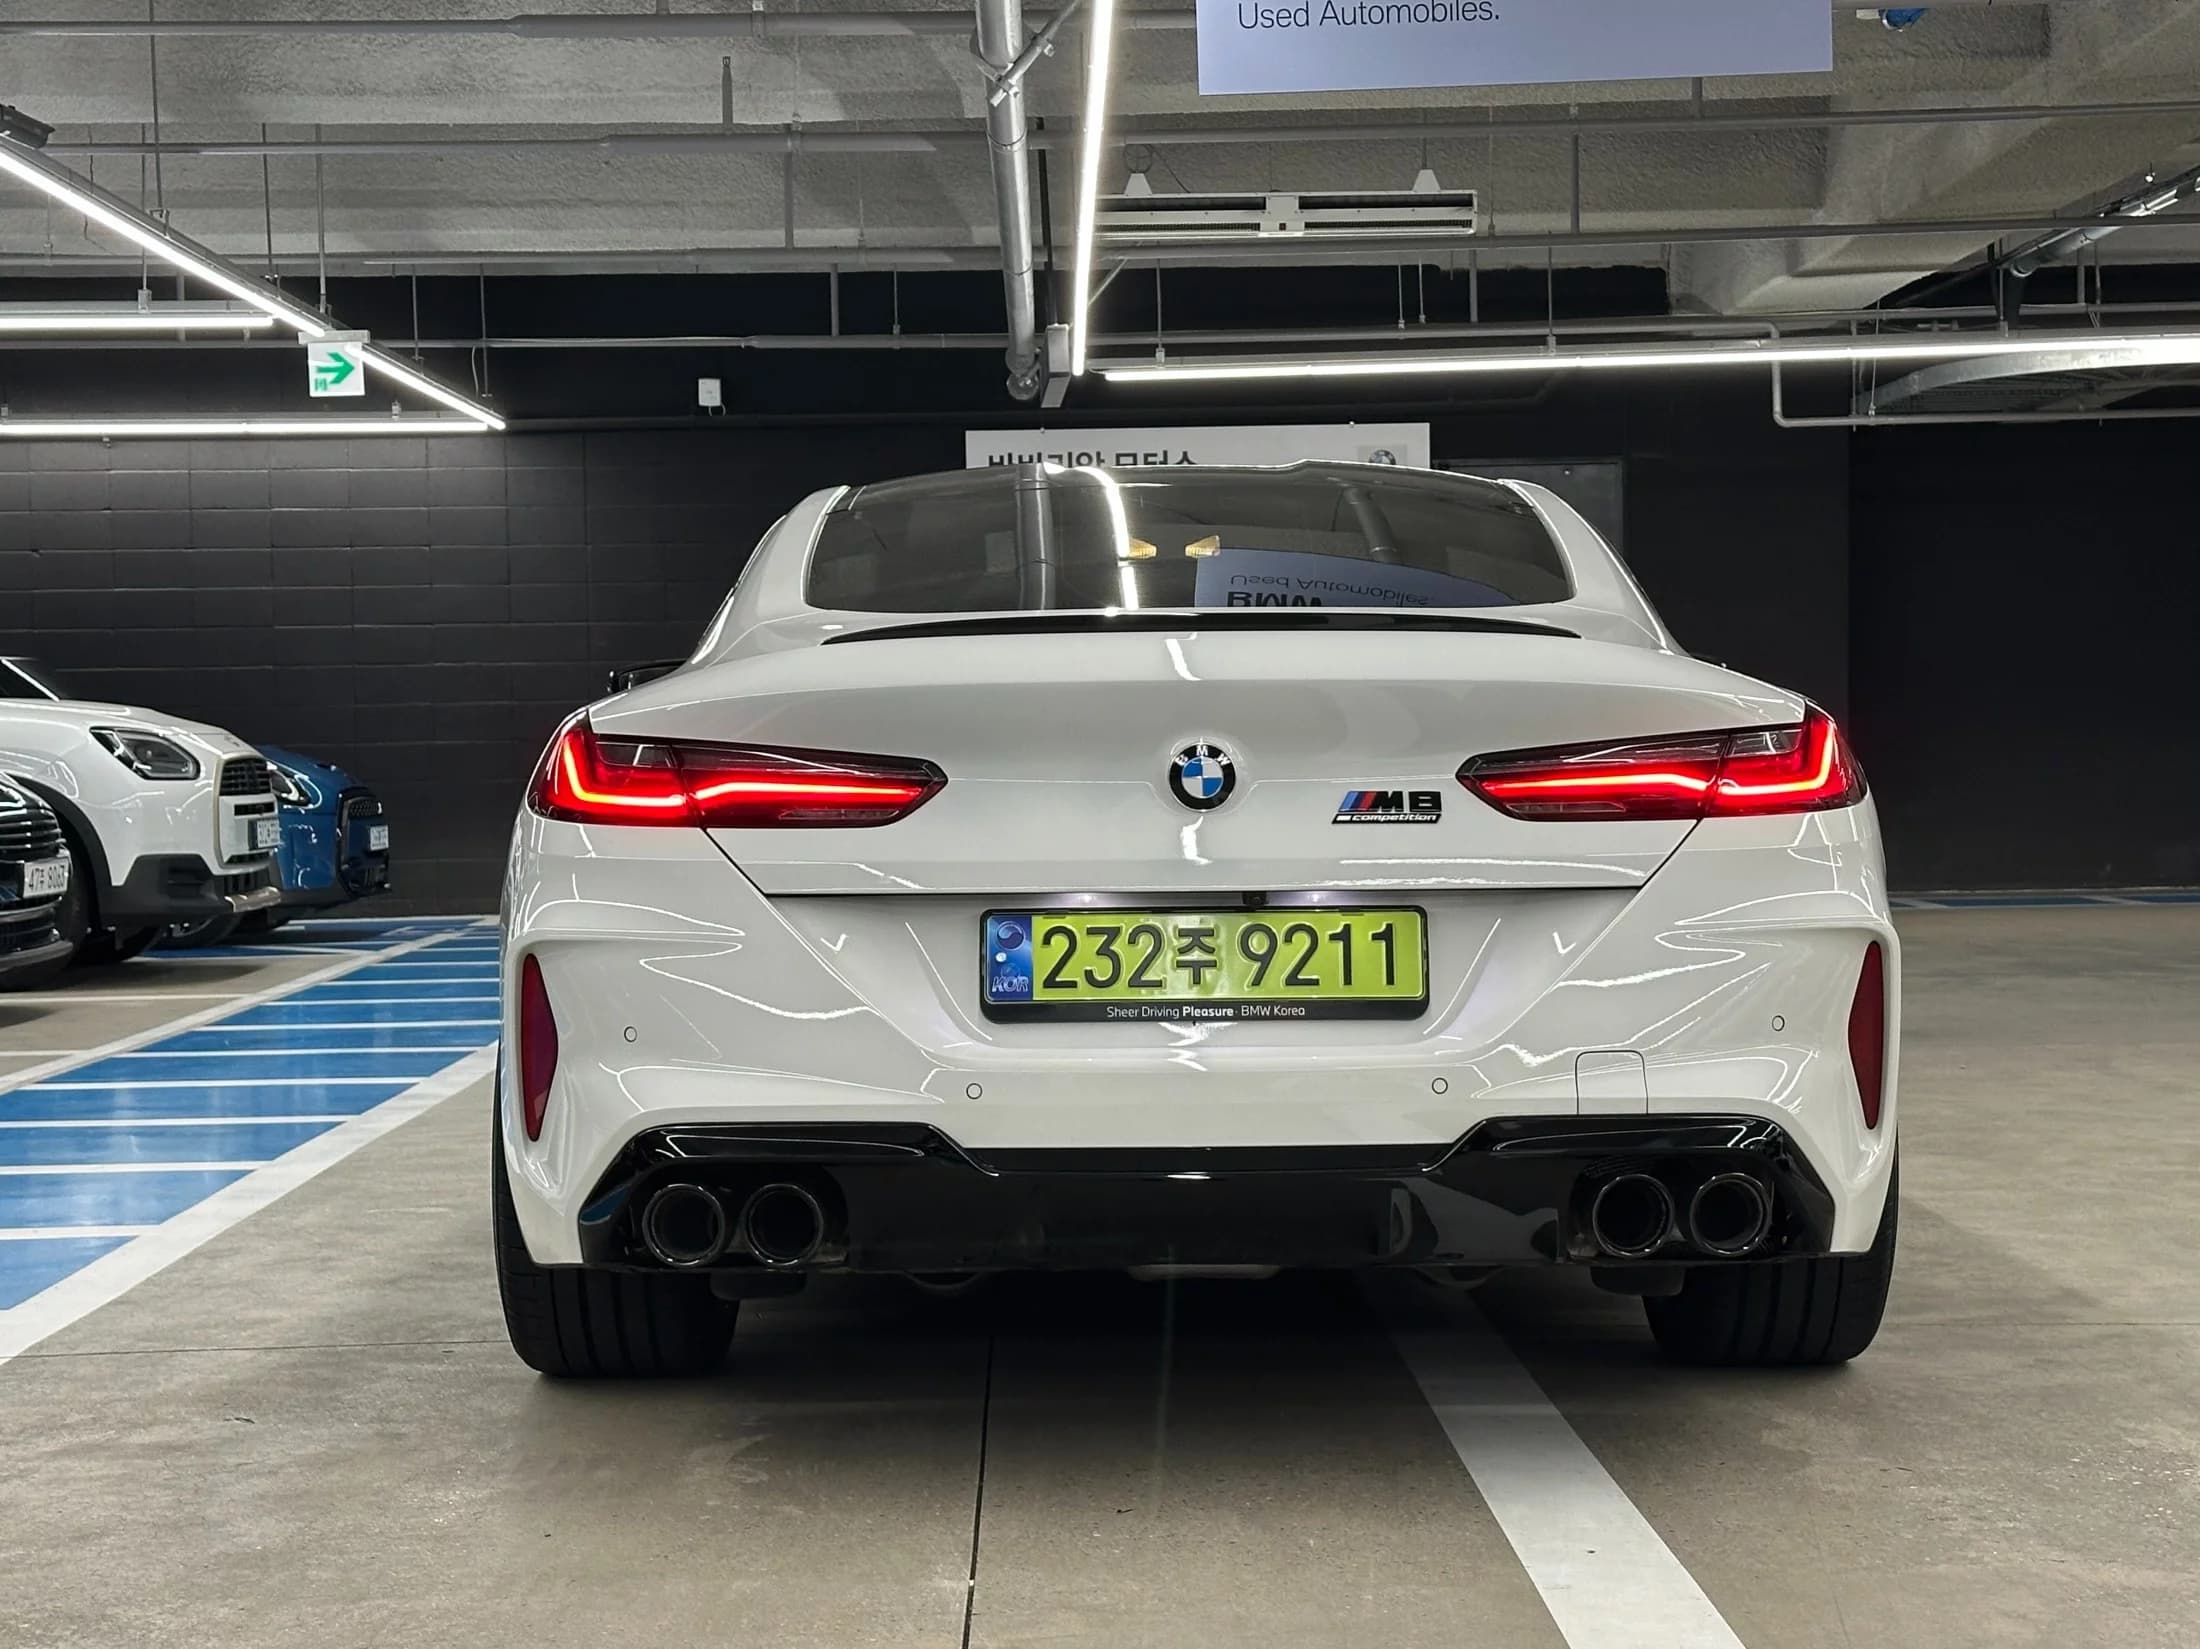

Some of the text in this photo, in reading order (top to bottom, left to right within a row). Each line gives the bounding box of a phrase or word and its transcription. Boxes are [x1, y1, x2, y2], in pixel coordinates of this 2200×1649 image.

[1238, 0, 1501, 30] Used Automobiles.
[1174, 744, 1232, 767] BMW
[1351, 813, 1438, 823] competition
[1236, 922, 1397, 988] 9211
[991, 975, 1030, 992] KOR
[1106, 1005, 1305, 1019] Sheer Driving Pleasure BMW Korea
